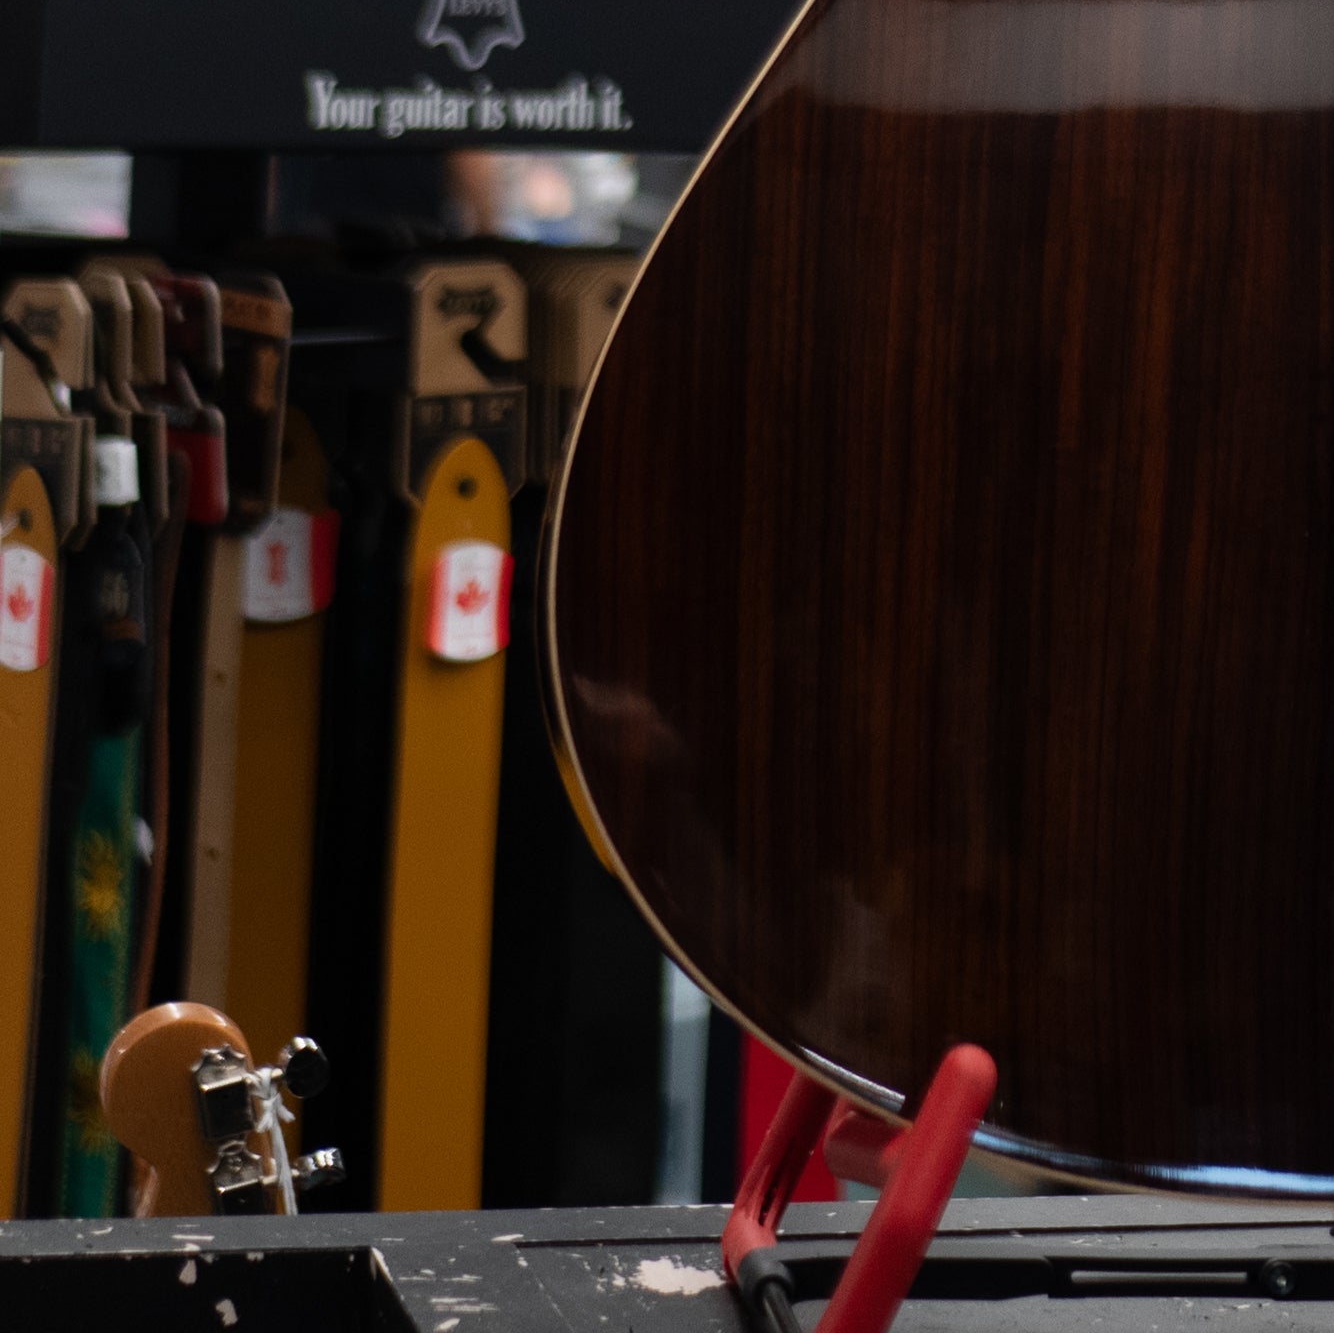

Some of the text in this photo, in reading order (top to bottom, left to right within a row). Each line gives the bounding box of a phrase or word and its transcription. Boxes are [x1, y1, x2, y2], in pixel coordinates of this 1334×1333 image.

[306, 70, 634, 139] Your guitar is worth it.
